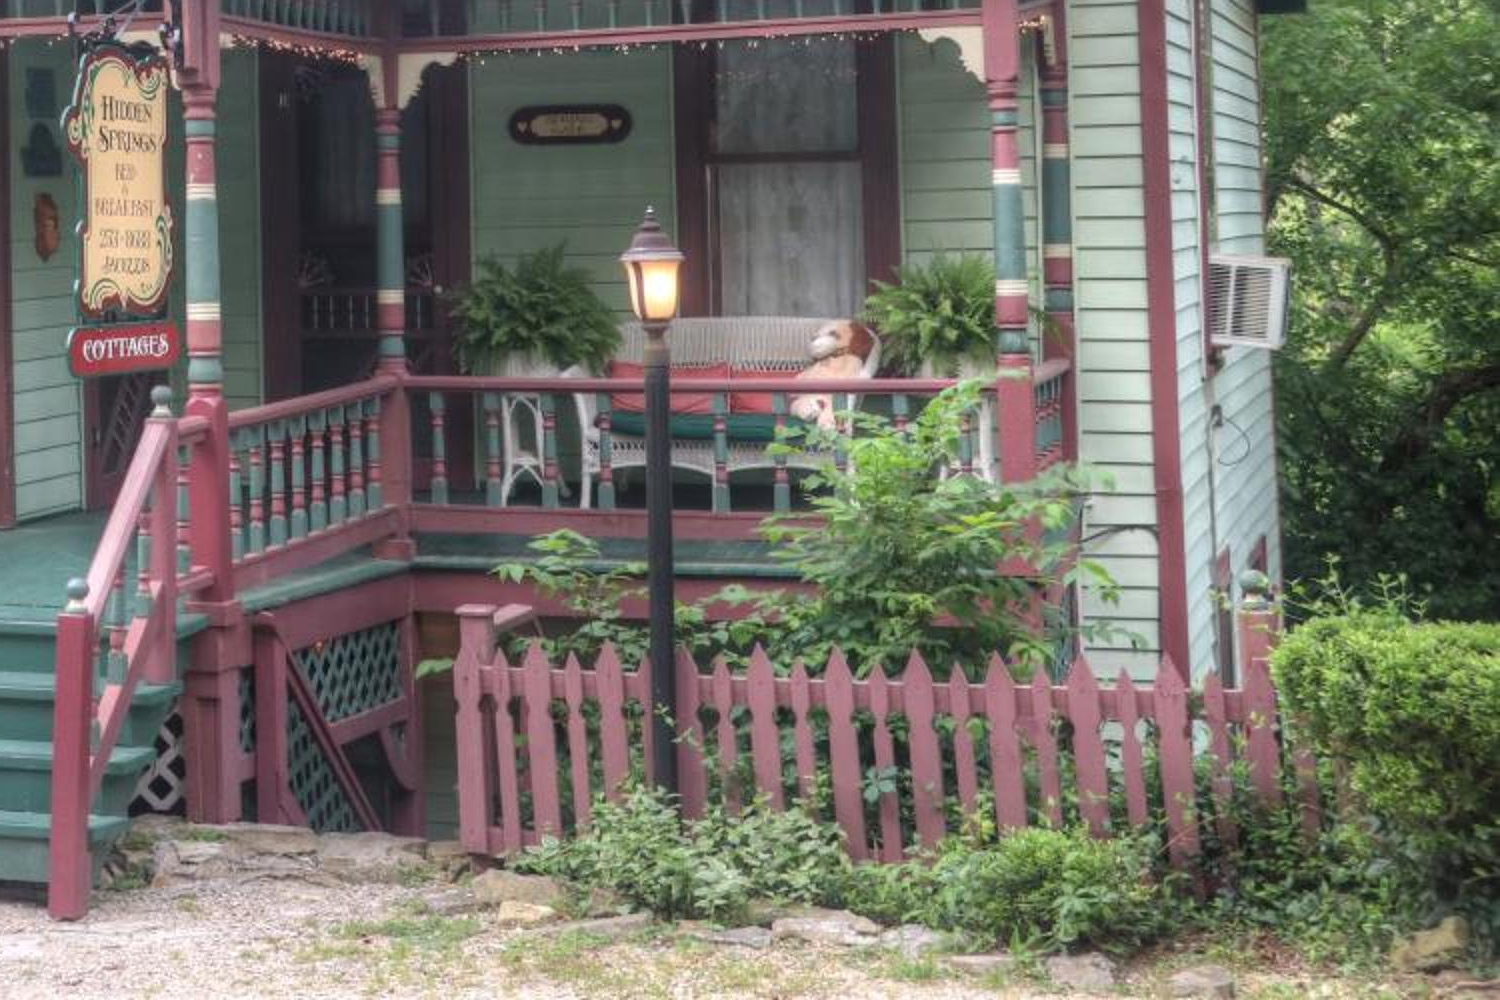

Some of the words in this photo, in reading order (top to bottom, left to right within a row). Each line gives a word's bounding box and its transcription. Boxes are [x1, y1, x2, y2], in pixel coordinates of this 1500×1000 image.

[101, 95, 153, 122] HIDDEN
[99, 125, 158, 152] SPRINGS
[115, 163, 136, 181] BED
[95, 198, 155, 217] BREAKFAST
[83, 333, 169, 363] COTTAGES
